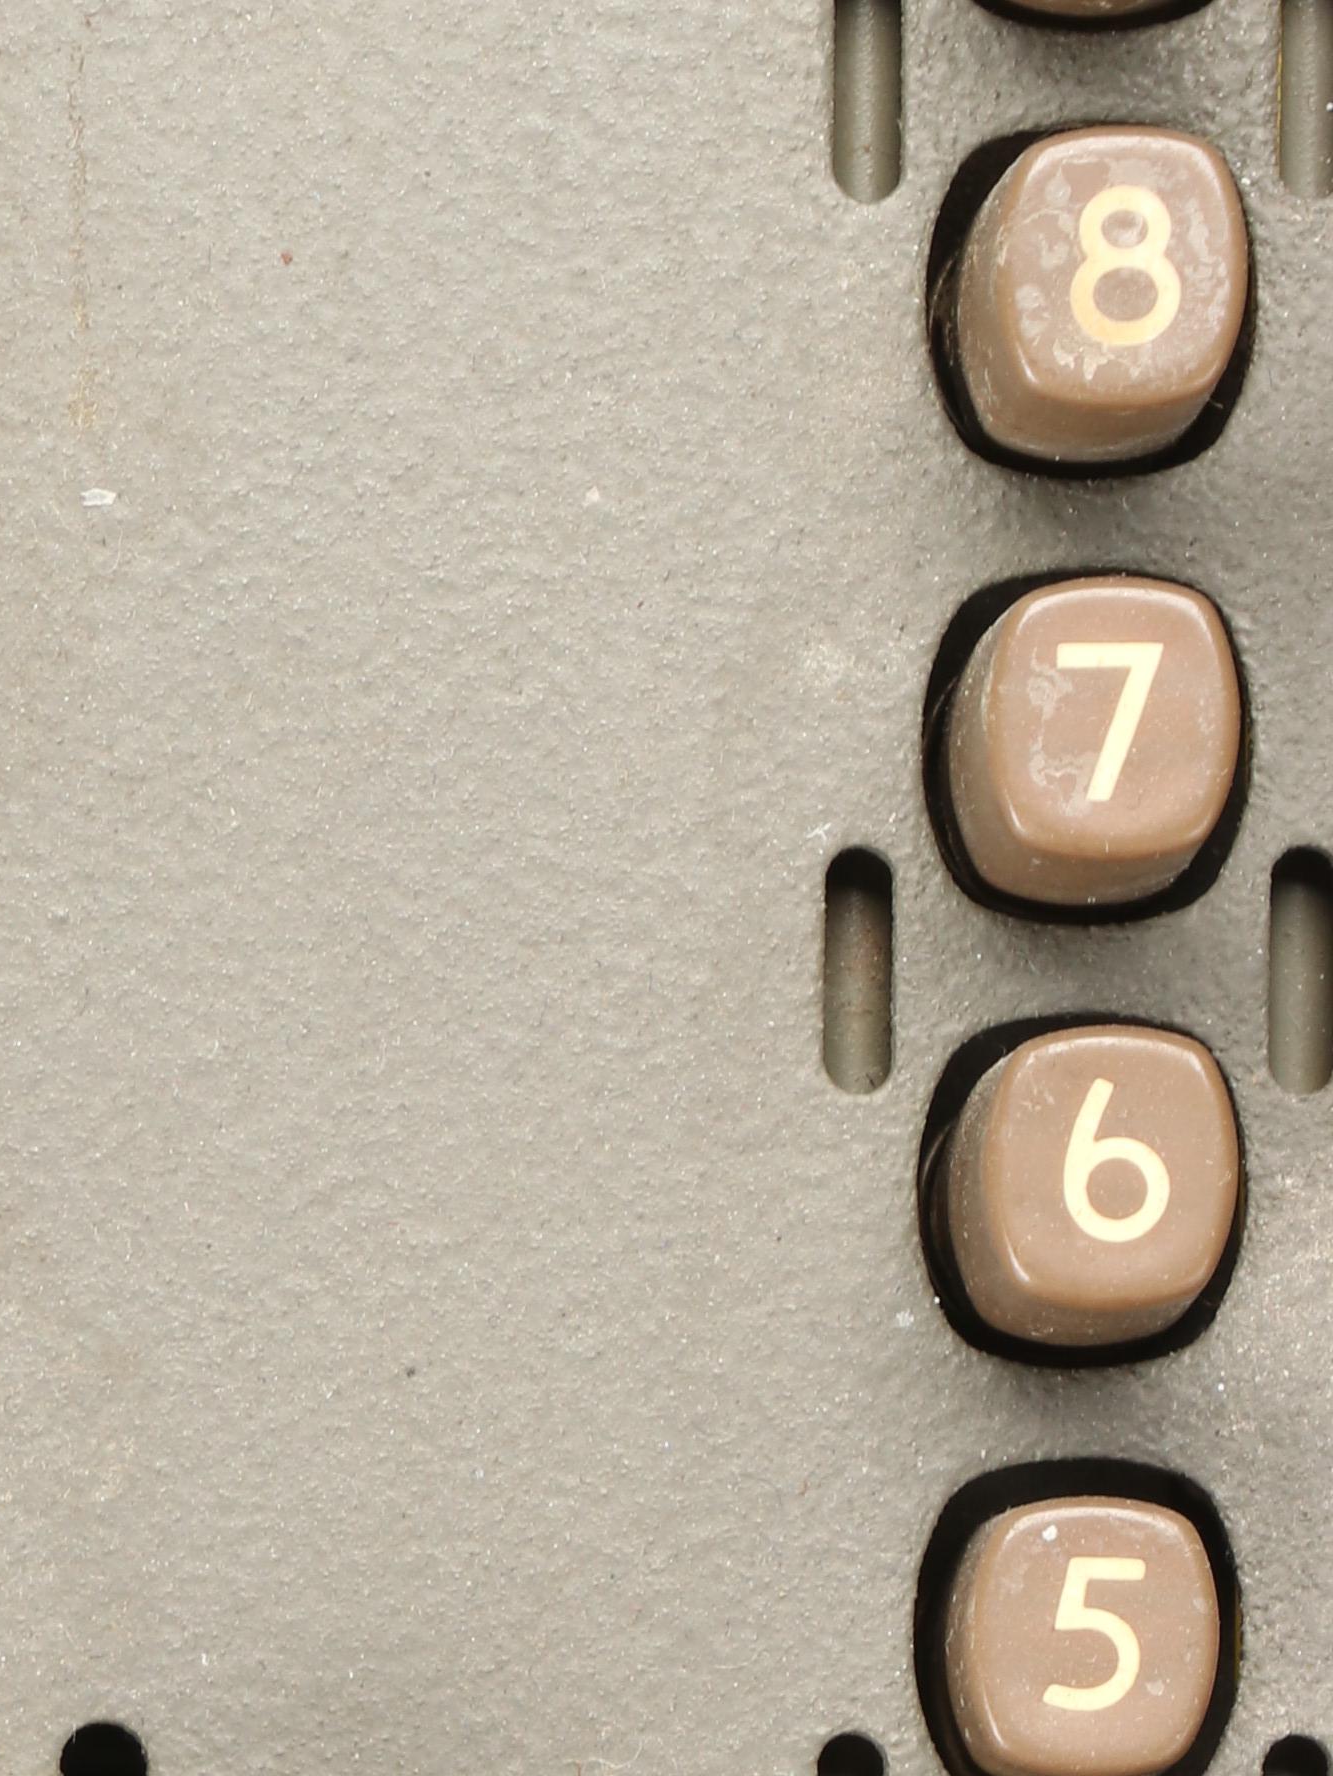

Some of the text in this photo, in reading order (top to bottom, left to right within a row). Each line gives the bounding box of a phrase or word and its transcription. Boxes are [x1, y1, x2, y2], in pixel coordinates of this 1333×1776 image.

[1071, 185, 1180, 351] 8
[1057, 643, 1163, 802] 7
[1064, 1079, 1169, 1242] 6
[1043, 1558, 1145, 1712] 5
